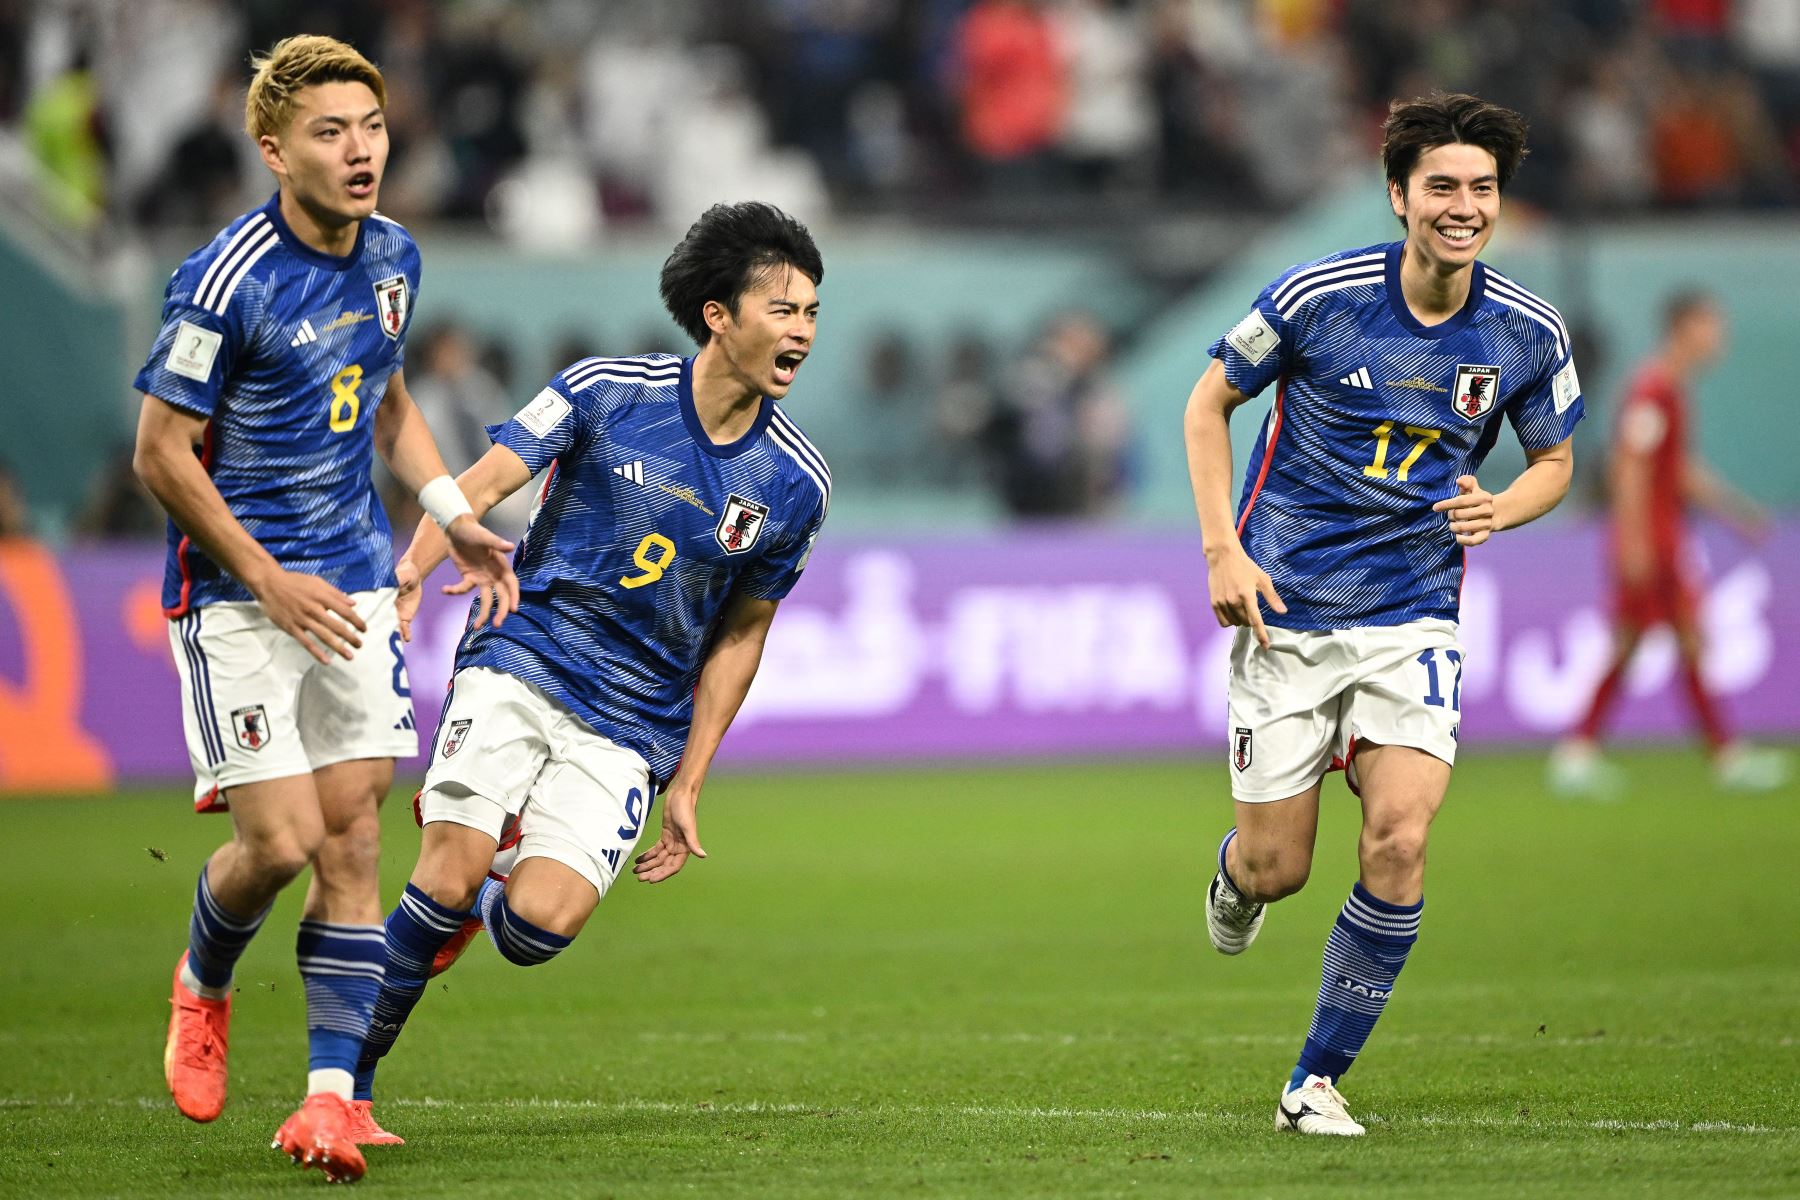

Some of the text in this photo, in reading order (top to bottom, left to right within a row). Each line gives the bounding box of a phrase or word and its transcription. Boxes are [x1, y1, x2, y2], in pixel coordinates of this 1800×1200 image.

[329, 364, 363, 433] 8
[1463, 403, 1482, 412] JFA
[1363, 420, 1441, 482] 17
[738, 499, 760, 511] JAPAN
[619, 533, 676, 589] 9
[724, 534, 743, 548] JFA
[389, 630, 412, 698] 8
[617, 787, 643, 840] 9
[1337, 979, 1394, 1000] JAPA
